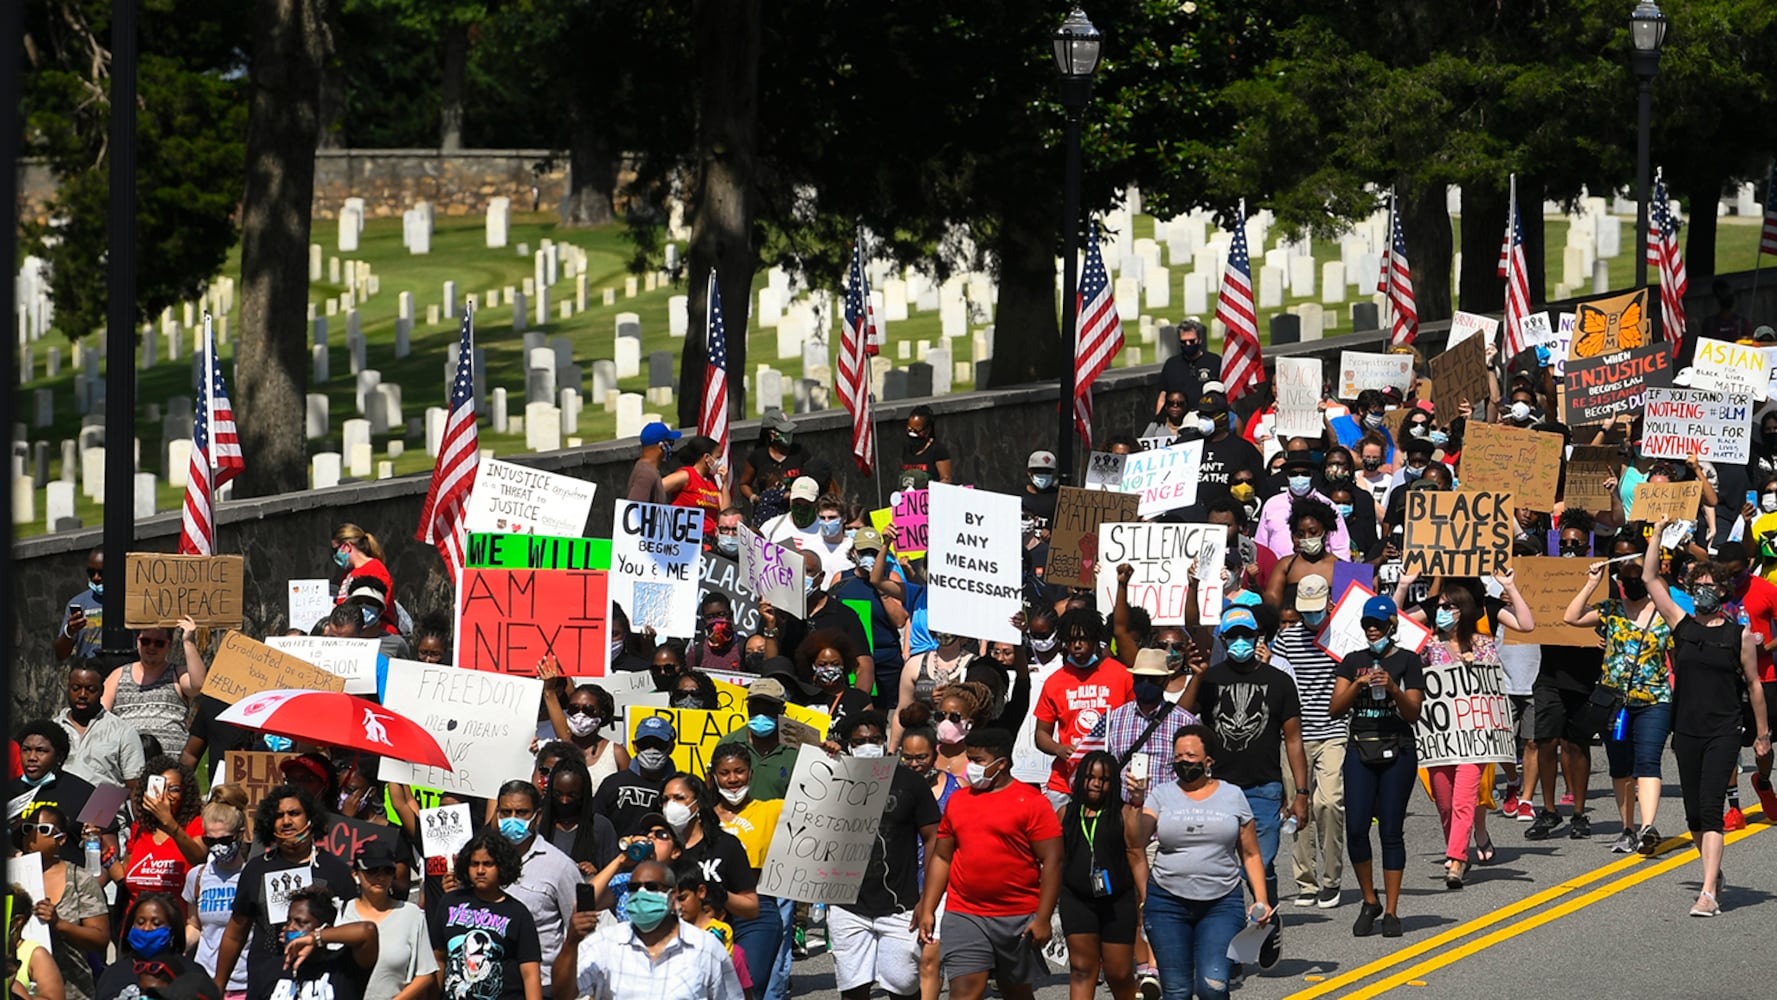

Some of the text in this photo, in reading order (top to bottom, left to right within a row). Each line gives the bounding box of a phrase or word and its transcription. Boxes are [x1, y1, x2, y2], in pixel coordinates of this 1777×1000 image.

[1603, 351, 1632, 365] WHEN
[1699, 341, 1764, 372] ASIAN
[1277, 363, 1319, 387] BLACK
[1567, 352, 1668, 392] INJUSTICE
[1571, 384, 1647, 409] RESISTANCE
[1588, 376, 1644, 396] BECOMES LAW
[1648, 389, 1749, 405] IF YOU STAND FOR
[1714, 381, 1759, 398] MATTER
[1584, 392, 1647, 418] BECOMES DU
[1647, 402, 1705, 420] NOTHING
[1277, 408, 1319, 430] MATTER
[1645, 421, 1745, 438] YOU'LL FALL FOR
[1207, 452, 1214, 461] I
[1483, 445, 1513, 462] George
[1643, 435, 1710, 456] ANYTHING
[1126, 449, 1194, 475] UALITY
[1200, 462, 1225, 472] AN'T
[486, 463, 552, 492] INJUSTICE
[1198, 473, 1230, 485] EATHE
[501, 484, 534, 502] THREAT
[1640, 485, 1699, 500] BLACK LIVES
[489, 497, 541, 521] JUSTICE
[965, 512, 985, 527] BY
[1408, 491, 1511, 522] BLACK
[1647, 502, 1687, 514] MATTER
[622, 503, 700, 544] CHANGE
[1406, 521, 1511, 551] LIVES
[469, 535, 592, 569] WE WILL
[639, 540, 680, 557] BEGINS
[956, 533, 989, 549] ANY
[1105, 525, 1221, 563] SILENCE
[136, 560, 230, 586] NO JUSTICE
[618, 553, 644, 577] YOU
[667, 563, 689, 581] ME
[946, 553, 999, 574] MEANS
[1139, 560, 1172, 584] IS
[1403, 549, 1511, 577] MATTER
[699, 555, 755, 599] BLAC
[928, 573, 1022, 600] NECCESSARY
[143, 586, 233, 618] NO PEACE
[463, 571, 604, 622] AM I
[225, 632, 282, 670] Graduated
[285, 666, 295, 676] as
[278, 640, 315, 649] WHITE
[475, 622, 599, 675] NEXT
[417, 669, 525, 715] FREEDOM
[1424, 664, 1503, 699] O JUSTICE
[463, 719, 510, 737] MEANS
[655, 710, 746, 747] BLAC
[1416, 701, 1450, 737] NO
[1417, 731, 1457, 761] BLACK
[1456, 729, 1487, 757] LIVES
[411, 763, 475, 792] FEAR
[800, 760, 880, 806] STOP
[791, 801, 881, 835] PRETENDING
[787, 822, 838, 862] YOUR
[150, 859, 176, 868] VOTE
[446, 902, 511, 939] VENOM
